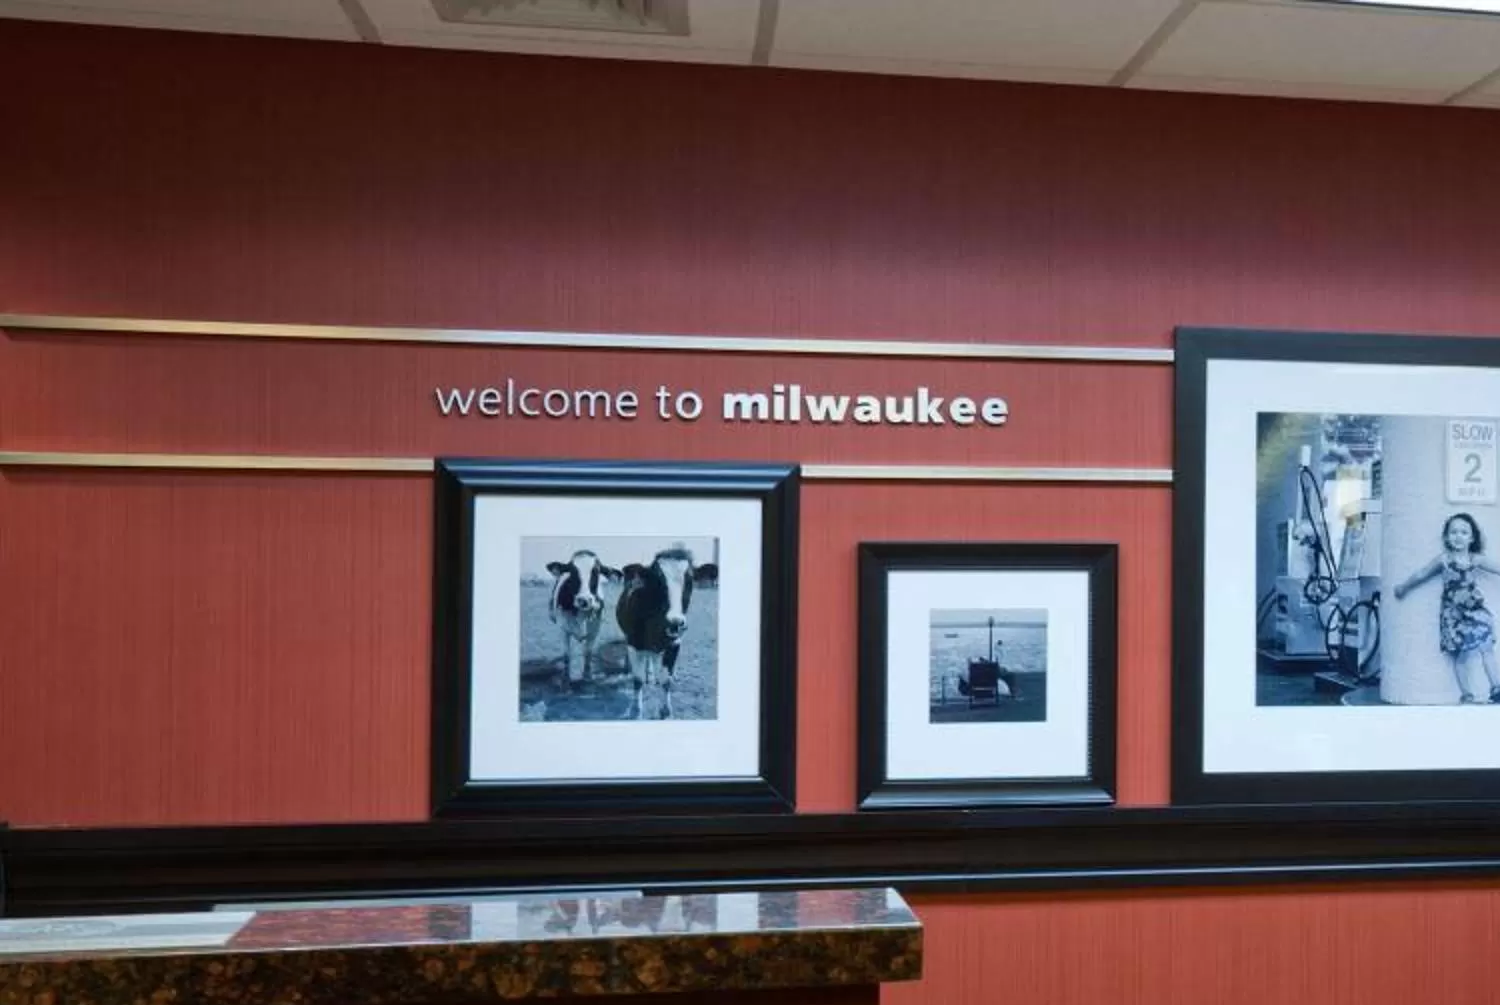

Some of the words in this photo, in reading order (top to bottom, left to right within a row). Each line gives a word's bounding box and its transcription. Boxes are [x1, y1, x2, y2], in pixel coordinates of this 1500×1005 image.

[436, 378, 639, 418] welcome
[656, 384, 704, 420] to
[723, 384, 1008, 425] milwaukee
[1452, 424, 1493, 441] SLOW
[1464, 453, 1482, 483] 2
